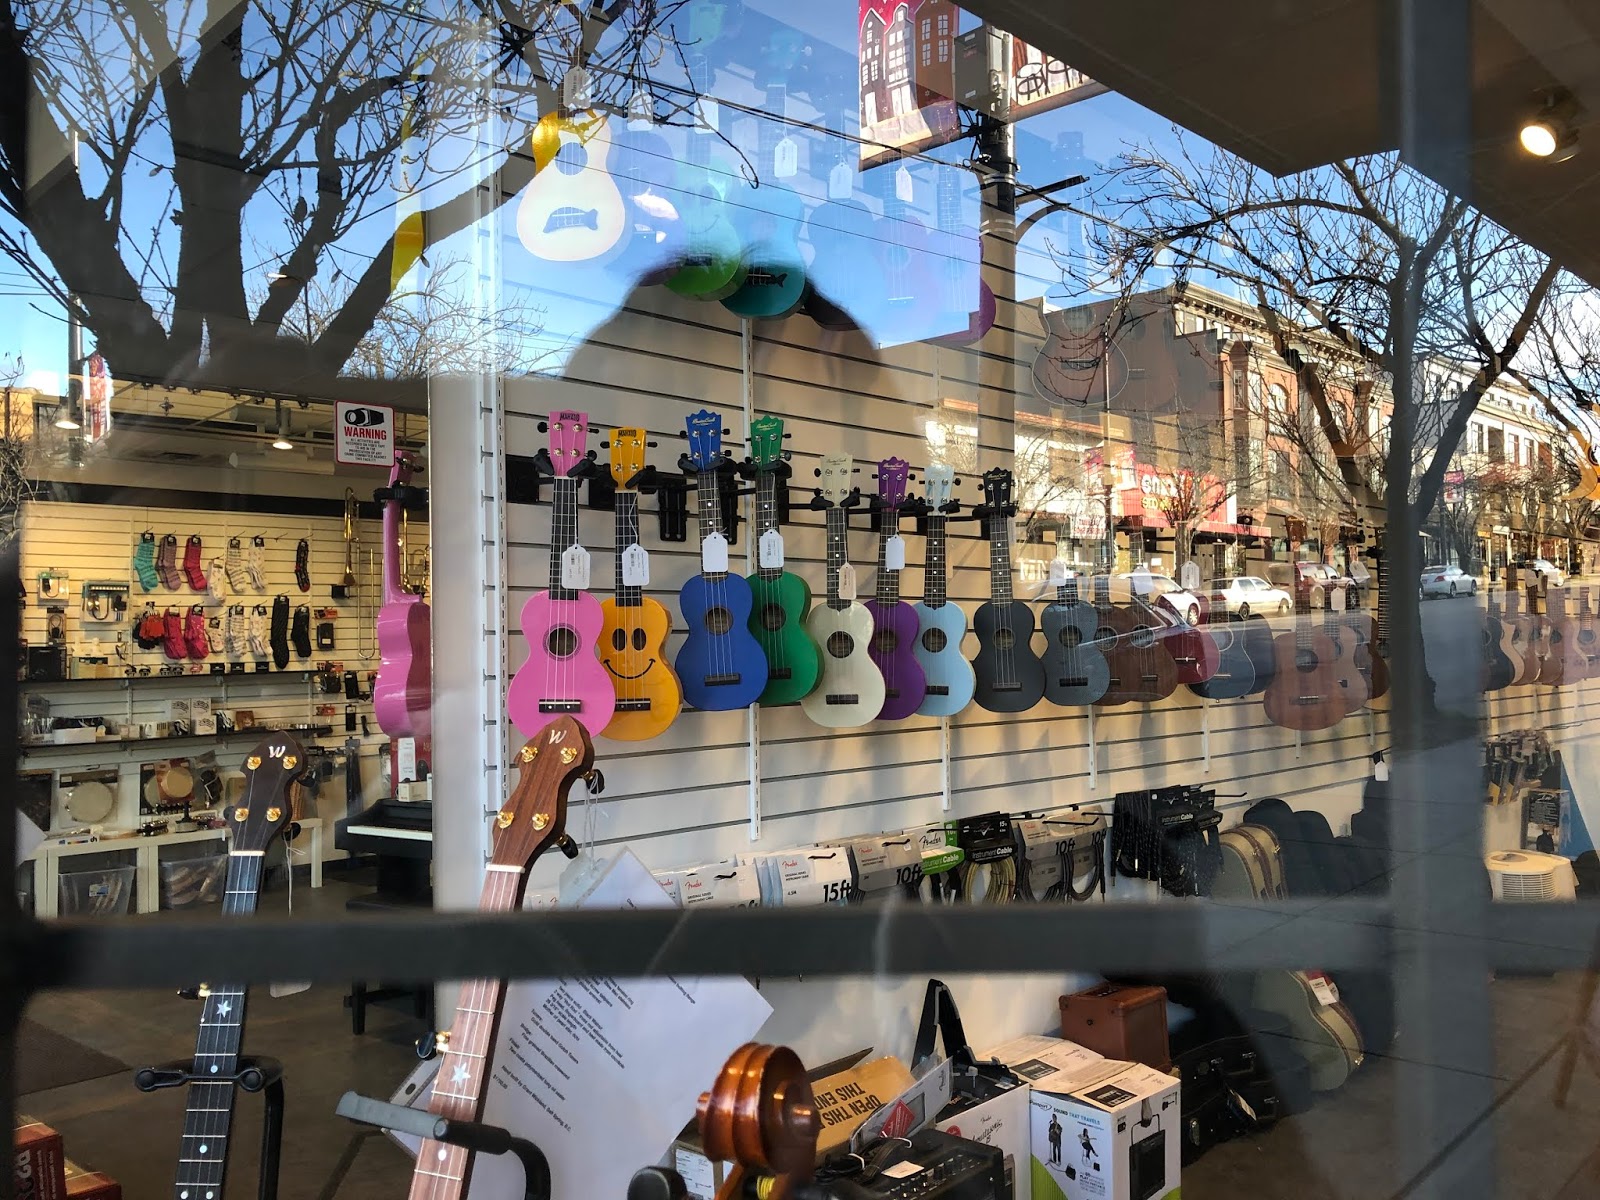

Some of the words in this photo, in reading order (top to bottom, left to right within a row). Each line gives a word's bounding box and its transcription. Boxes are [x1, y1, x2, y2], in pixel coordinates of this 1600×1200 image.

[344, 426, 387, 440] WARNING
[1180, 812, 1194, 820] Cable
[919, 833, 942, 849] Fender
[1055, 838, 1076, 856] 10ft
[943, 853, 960, 863] Cable
[972, 849, 997, 859] Instrument
[996, 846, 1013, 854] Cable
[896, 863, 923, 885] 10ft
[823, 880, 852, 903] 15ft
[835, 1082, 867, 1102] THIS
[848, 1094, 882, 1116] OPEN
[822, 1106, 853, 1126] THIS
[1053, 1107, 1069, 1116] SOUND
[1081, 1115, 1101, 1126] TRAVELS
